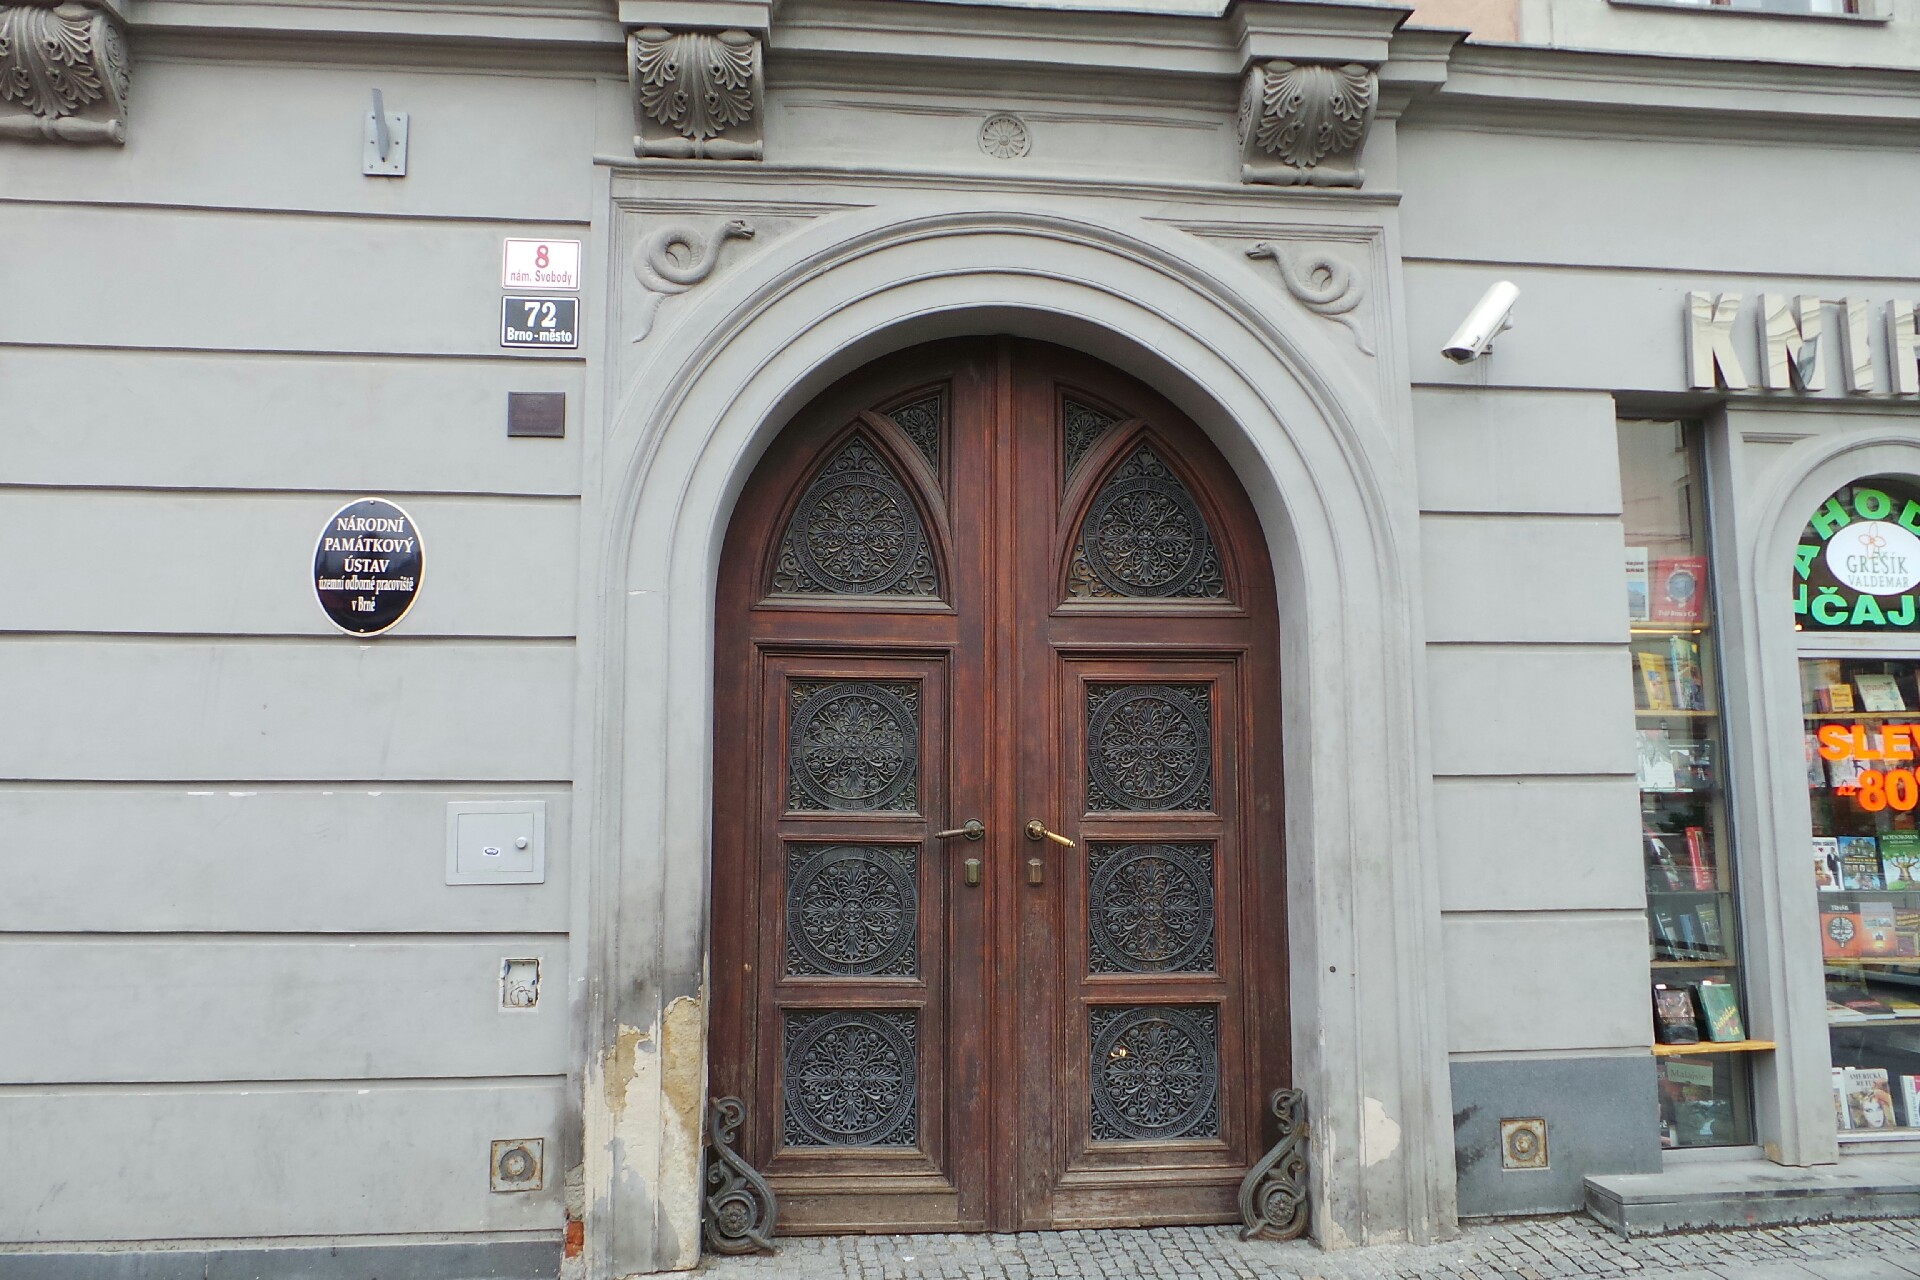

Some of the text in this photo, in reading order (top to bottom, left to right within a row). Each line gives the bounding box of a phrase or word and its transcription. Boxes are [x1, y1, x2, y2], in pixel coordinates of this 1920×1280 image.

[534, 244, 550, 269] 8
[510, 269, 572, 286] nám. Svobody
[524, 301, 557, 328] 72
[336, 515, 405, 533] NÁRODNÍ
[324, 535, 415, 553] PAMÁTKOVÝ
[344, 555, 390, 573] ÚSTAV
[1846, 552, 1909, 575] GREŠÍK
[318, 574, 414, 595] územní odborné pracoviště
[1847, 575, 1910, 588] VALDEMAR
[351, 596, 376, 612] v Brně
[1811, 586, 1920, 626] ČAJ
[1858, 766, 1920, 812] 80
